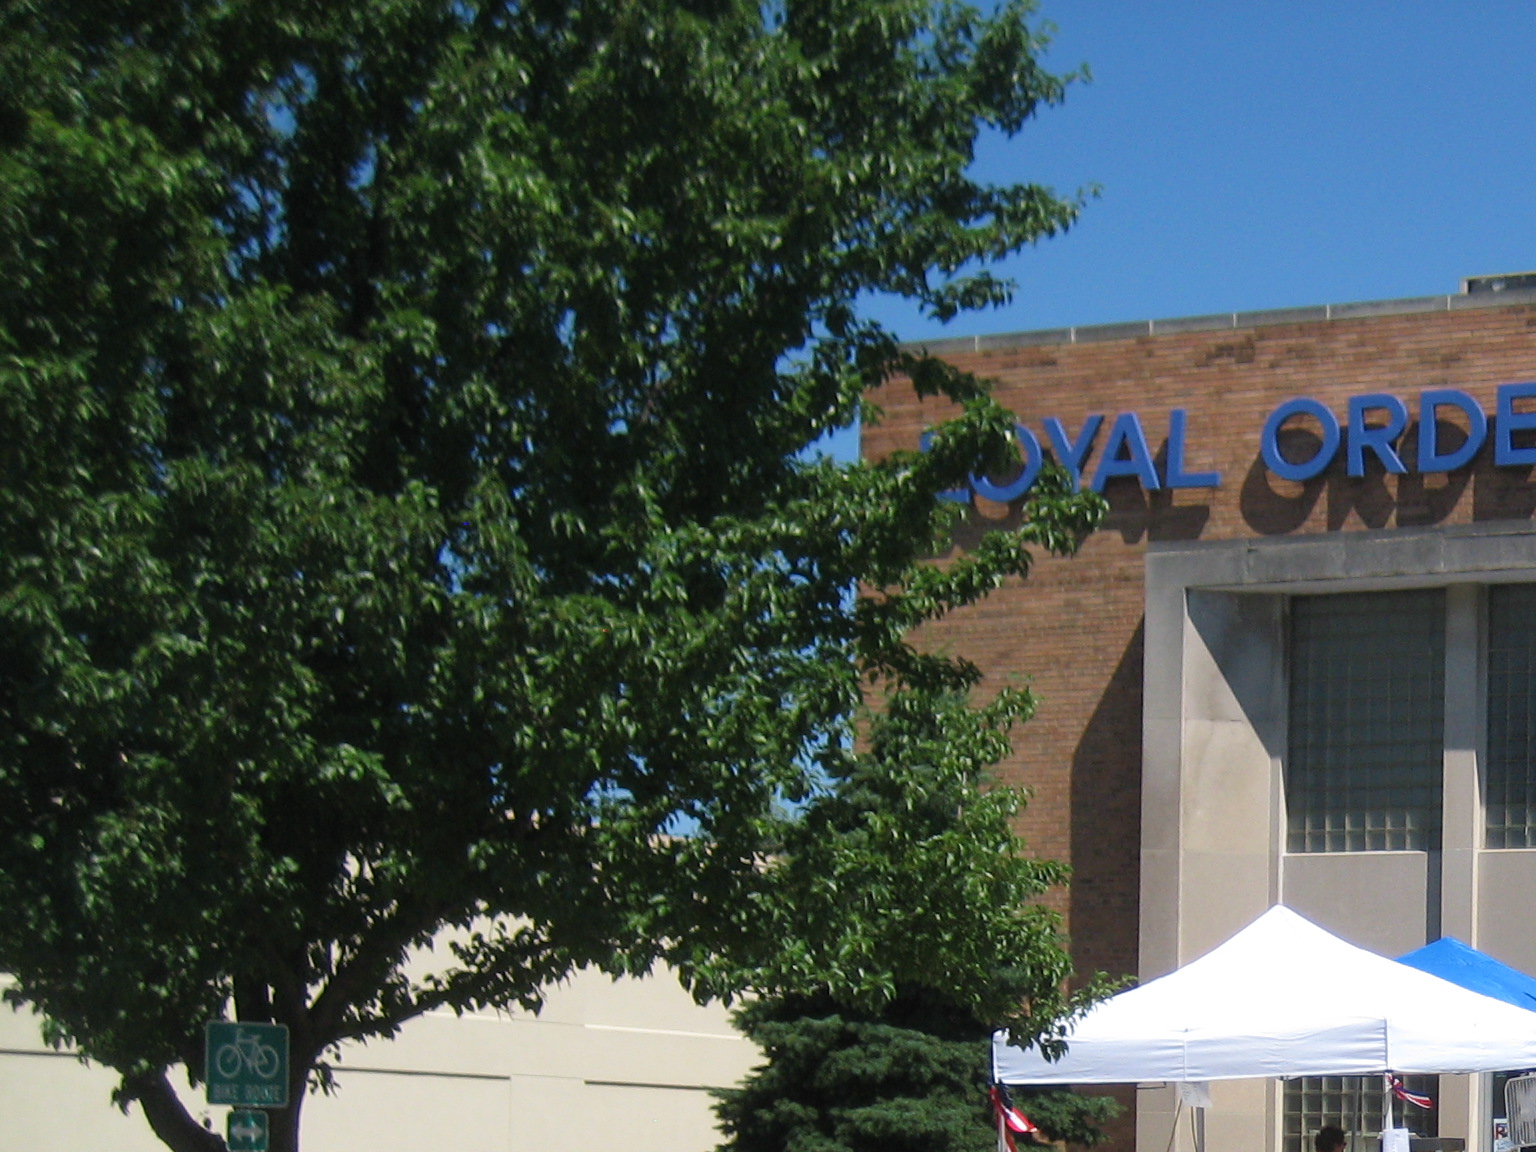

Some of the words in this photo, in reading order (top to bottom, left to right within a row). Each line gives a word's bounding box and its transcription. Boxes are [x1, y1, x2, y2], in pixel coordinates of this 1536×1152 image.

[918, 409, 1221, 503] OYAL
[212, 1083, 239, 1099] BIKE
[245, 1084, 281, 1100] ROUTE
